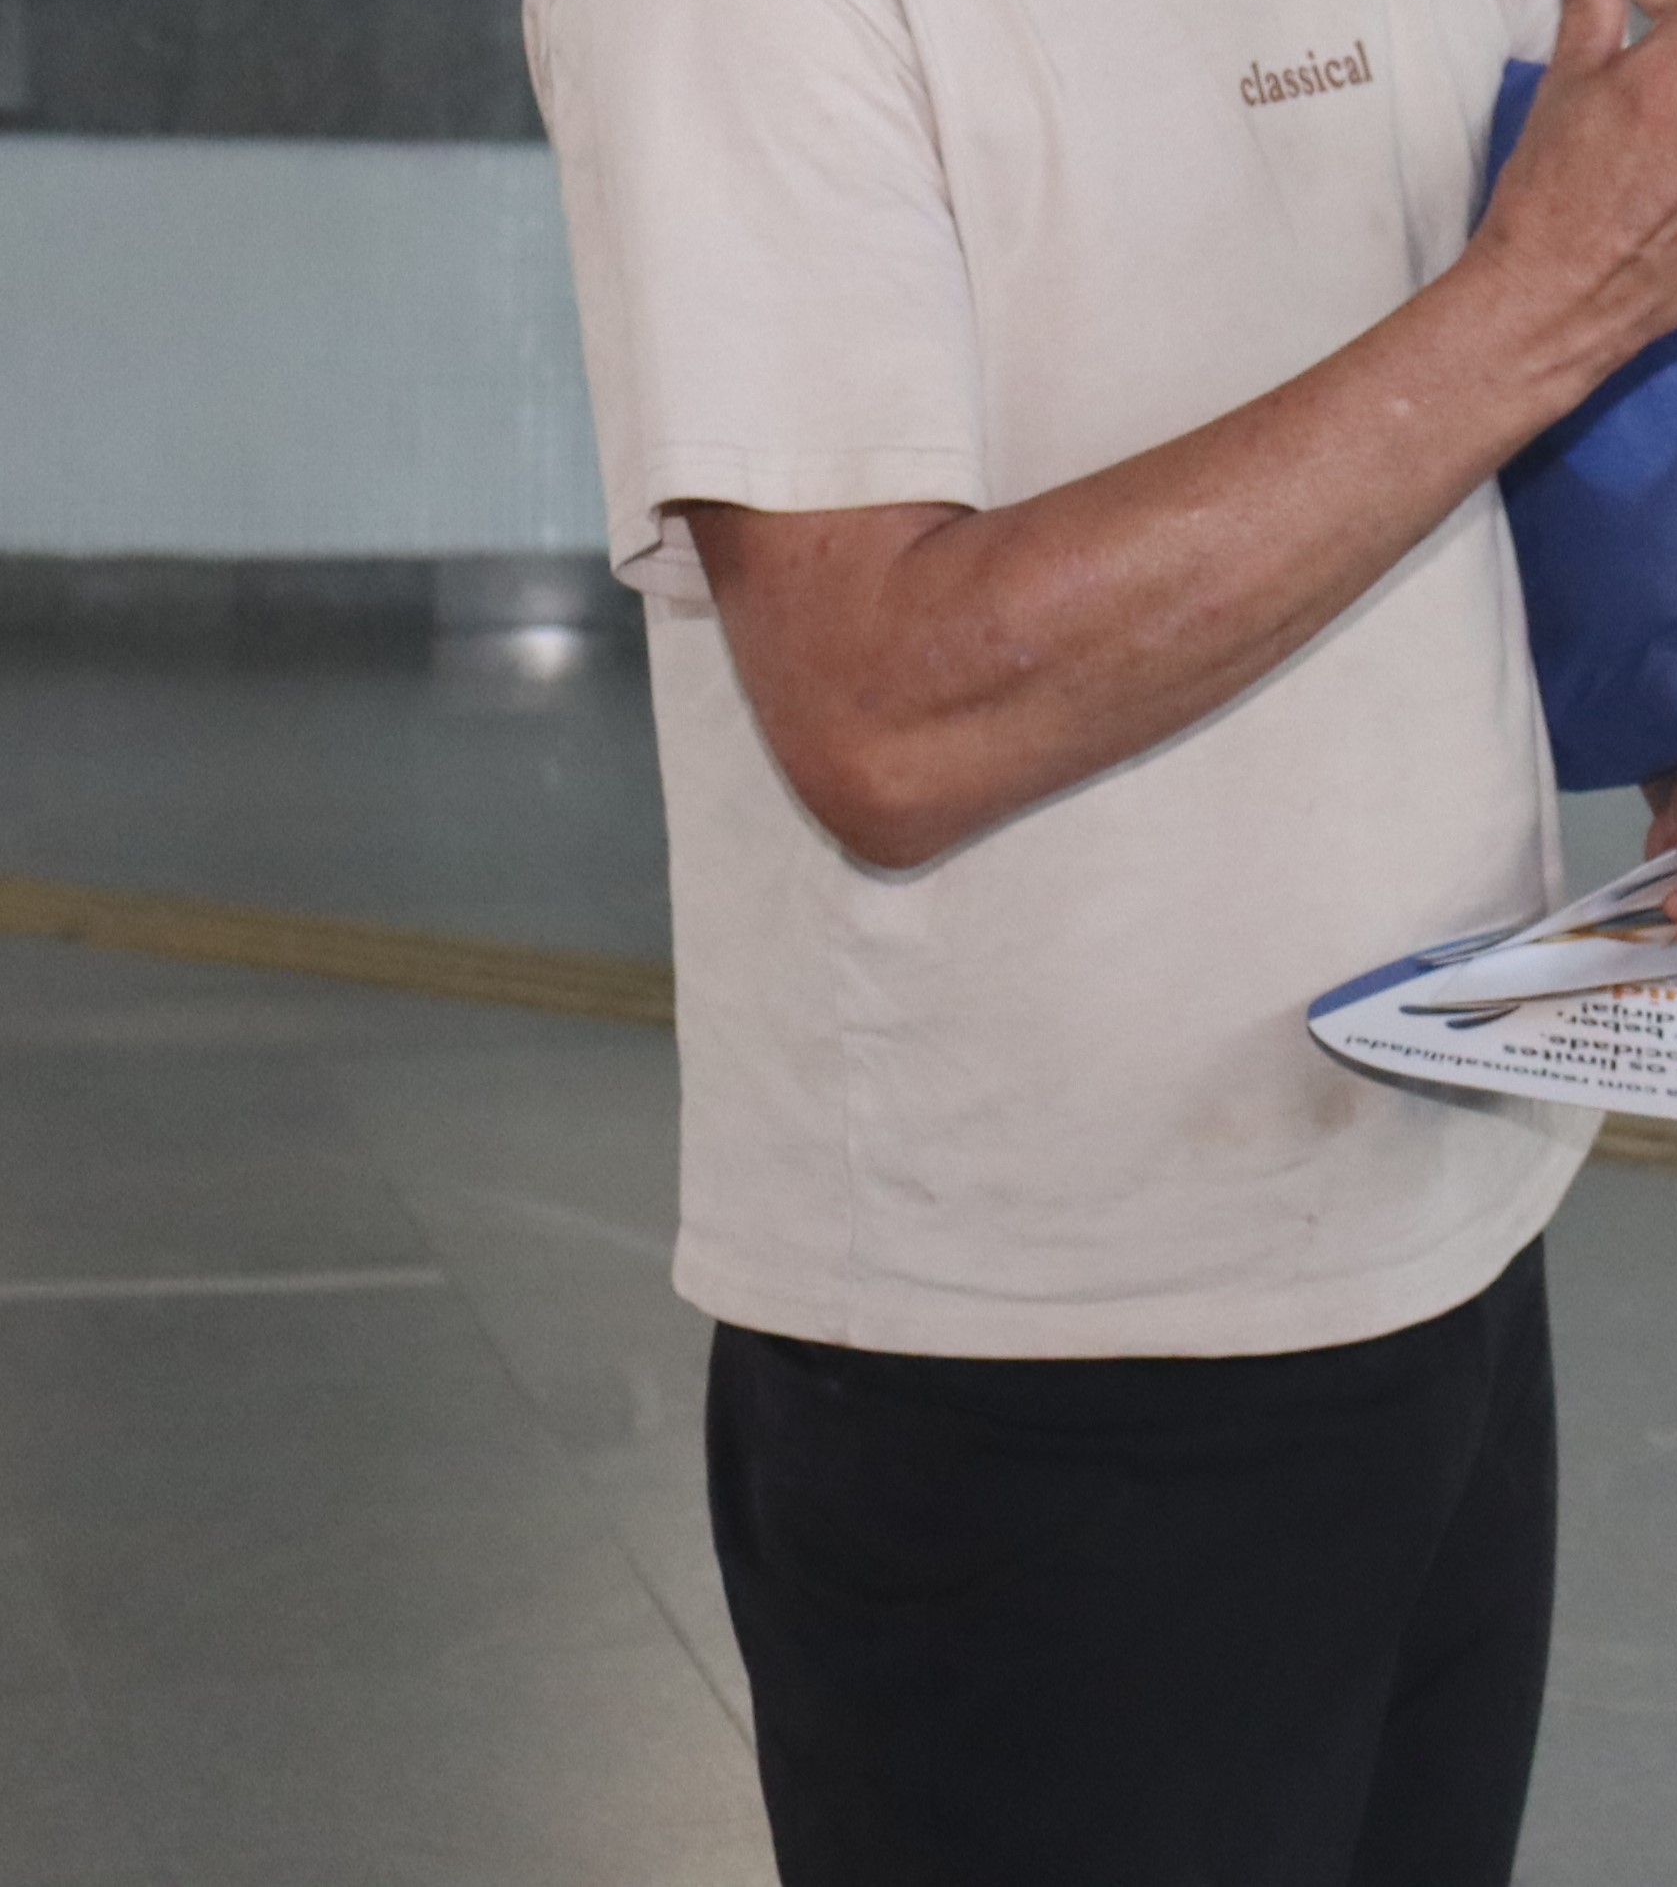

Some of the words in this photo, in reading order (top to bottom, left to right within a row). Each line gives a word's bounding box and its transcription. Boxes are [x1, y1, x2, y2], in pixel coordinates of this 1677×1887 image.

[1240, 39, 1373, 106] classical
[1579, 1001, 1676, 1022] dirija!
[1343, 1034, 1589, 1085] responsabilidade!
[1502, 1043, 1618, 1069] limites
[1627, 1059, 1667, 1072] os
[1596, 1077, 1659, 1096] com
